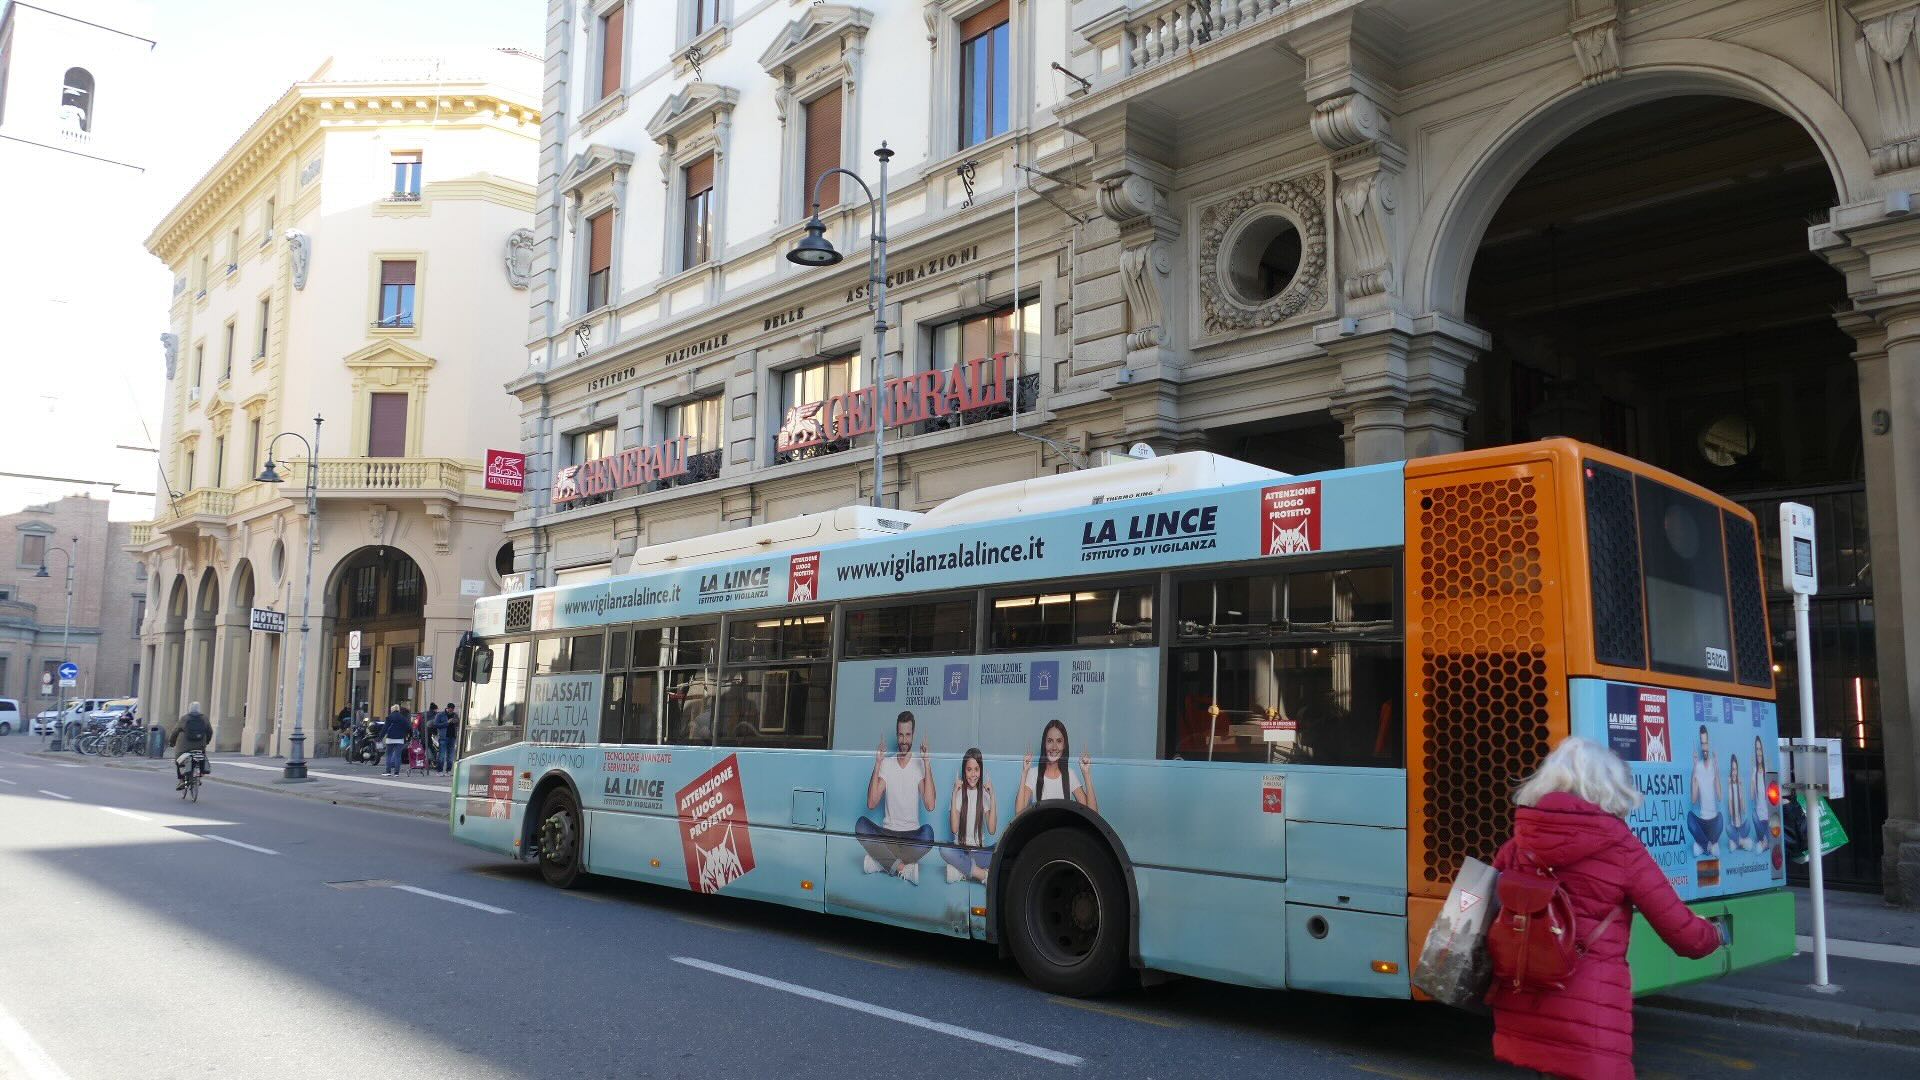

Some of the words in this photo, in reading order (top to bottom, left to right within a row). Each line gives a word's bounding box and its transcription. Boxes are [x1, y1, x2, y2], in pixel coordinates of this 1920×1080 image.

[588, 367, 636, 392] ISTITUTO
[665, 334, 728, 366] NAZIONALE
[764, 307, 804, 331] DELLE
[846, 245, 978, 303] ASSCURAZIONI
[823, 352, 1010, 441] GENERALI
[1872, 409, 1890, 435] 9
[580, 436, 689, 498] GENERALI
[488, 477, 522, 487] GENERALI
[1265, 487, 1316, 500] ATTENZIONE
[1273, 499, 1304, 509] LUOGO
[1270, 508, 1311, 520] PROTETTO
[1083, 519, 1117, 546] LA
[1128, 506, 1218, 541] LINCE
[837, 536, 1045, 582] www.vigilanzalalince.it
[1081, 549, 1129, 561] ISTITUTO
[1133, 547, 1145, 556] DI
[1151, 538, 1217, 555] VIGILANZA
[700, 574, 718, 592] LA
[724, 567, 770, 589] LINCE
[564, 584, 681, 616] www.vigilanzalalince.it
[698, 595, 723, 605] ISTITUTO
[726, 594, 732, 602] DI
[734, 590, 768, 601] VIGILANZA
[254, 610, 284, 625] HOTEL
[1072, 660, 1092, 671] RADIO
[1072, 672, 1105, 683] PATTUGLIA
[535, 682, 592, 701] RILASSATI
[1072, 684, 1084, 695] H24
[1640, 693, 1666, 703] ATTENZIONE
[532, 706, 560, 726] ALLA
[564, 706, 589, 727] TUA
[1609, 713, 1617, 723] LA
[1619, 713, 1637, 724] LINCE
[527, 752, 567, 768] PENSIAMO
[570, 754, 585, 769] NOI
[604, 752, 639, 763] TECNOLOGIE
[640, 753, 672, 764] AVANZATE
[604, 777, 620, 794] LA
[625, 778, 665, 798] LINCE
[681, 766, 734, 811] ATTENZIONE
[603, 799, 625, 807] ISTITUTO
[627, 800, 633, 808] DI
[634, 801, 663, 810] VIGILANZA
[691, 792, 723, 820] LUOGO
[1661, 799, 1685, 822] TUA
[689, 803, 735, 840] PROTETTO
[1674, 850, 1688, 865] NOI
